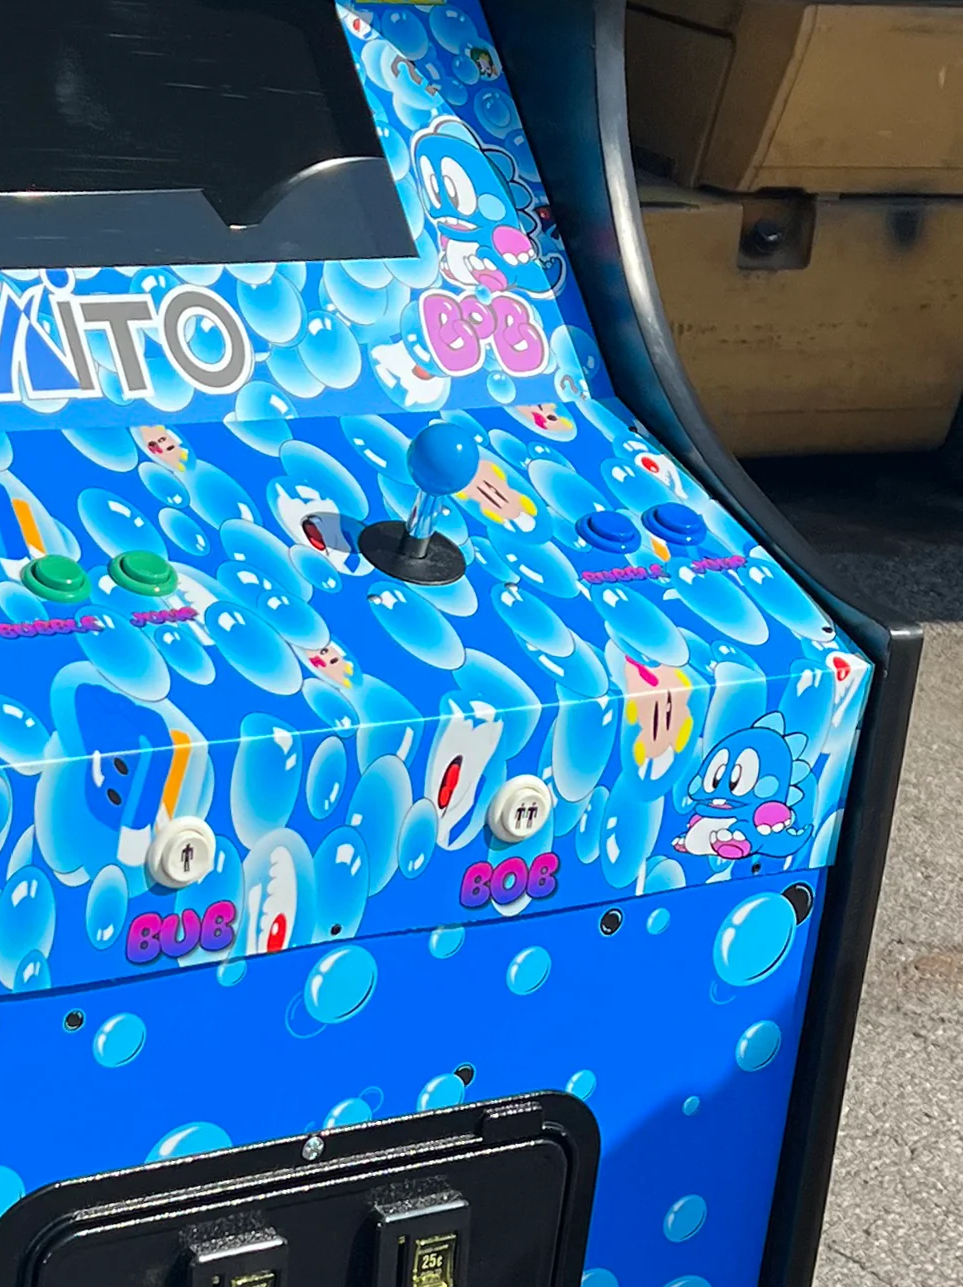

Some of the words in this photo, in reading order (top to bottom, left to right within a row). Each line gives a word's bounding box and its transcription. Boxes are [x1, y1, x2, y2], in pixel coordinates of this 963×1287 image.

[418, 286, 548, 376] BOB
[459, 851, 560, 909] BOB
[125, 899, 238, 965] BUB
[422, 1253, 443, 1269] 25¢
